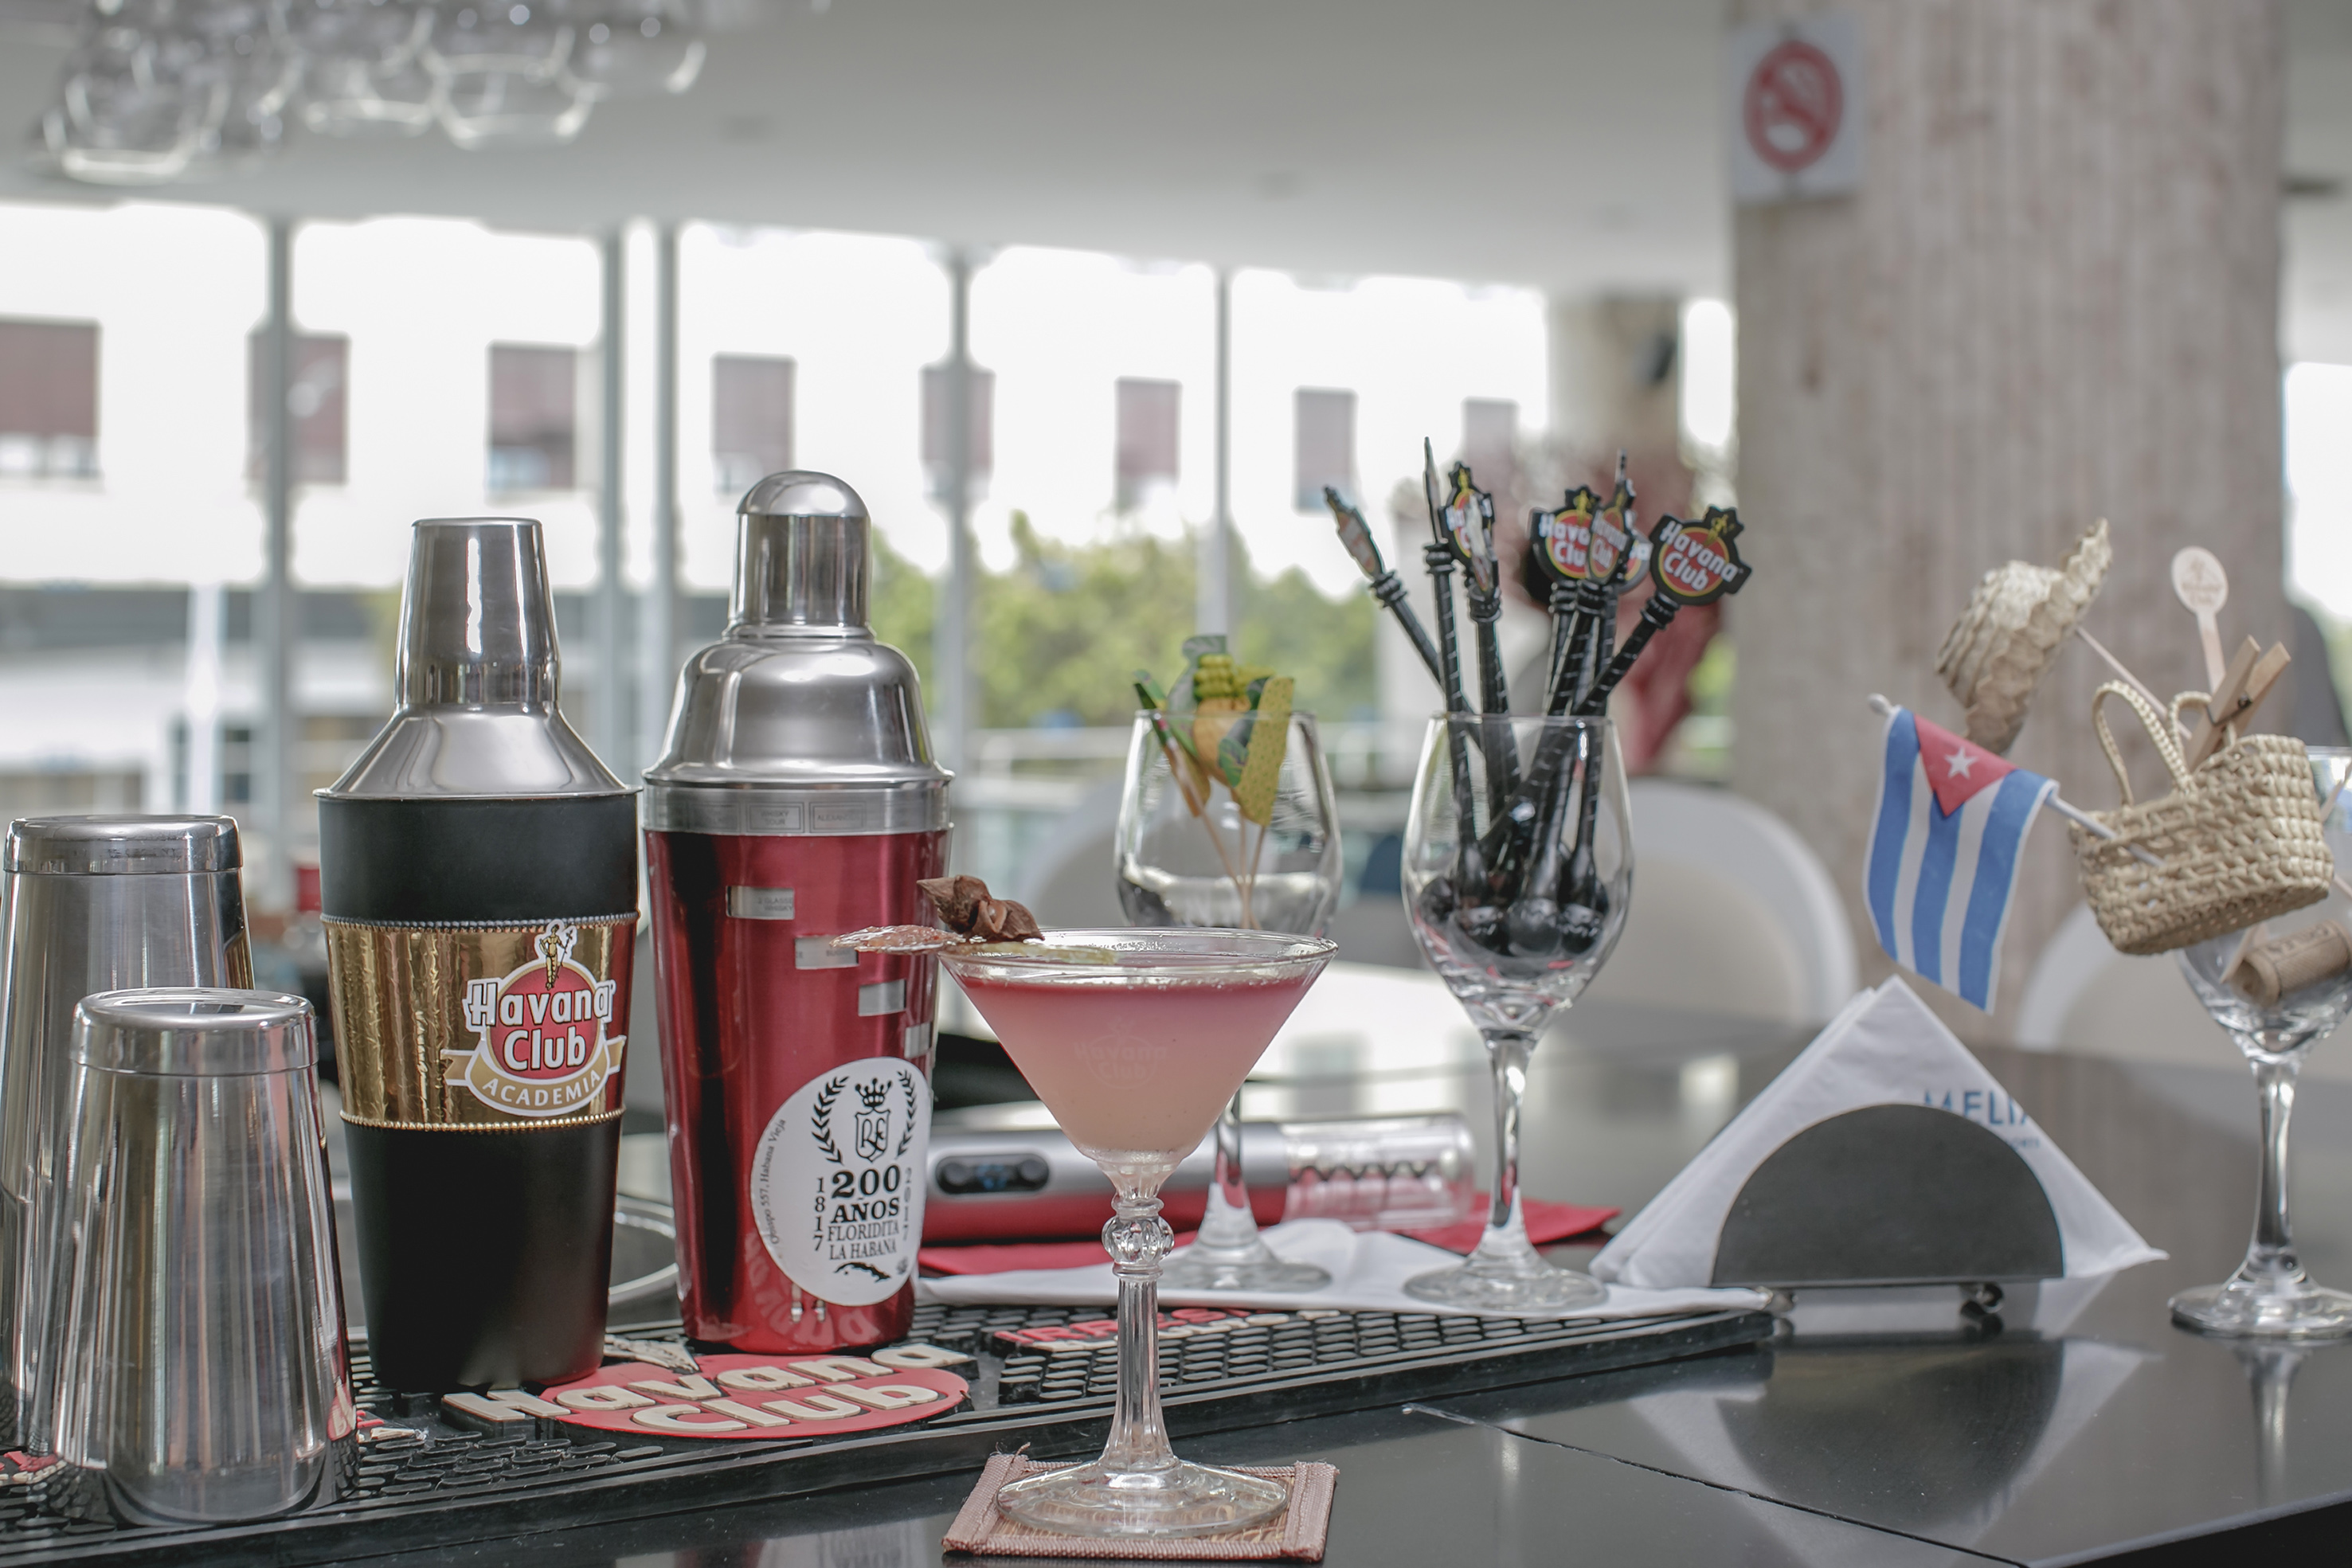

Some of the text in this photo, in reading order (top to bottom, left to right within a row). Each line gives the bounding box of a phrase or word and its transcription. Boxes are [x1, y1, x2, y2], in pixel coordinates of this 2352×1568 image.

[1539, 514, 1590, 544] Hava
[1554, 542, 1587, 566] Clu
[1659, 521, 1739, 582] Havana
[1664, 551, 1709, 591] Club
[469, 982, 612, 1026] Havana
[503, 1027, 586, 1071] Club
[483, 1070, 601, 1107] ACADEMIA
[759, 1146, 775, 1183] Habana
[768, 1118, 787, 1143] Vieja
[832, 1164, 901, 1199] 200
[830, 1196, 900, 1223] AÑOS
[828, 1219, 898, 1242] FLORIDITA
[829, 1238, 897, 1260] LA HABANA
[443, 1343, 970, 1421] Havana
[632, 1382, 939, 1433] Club
